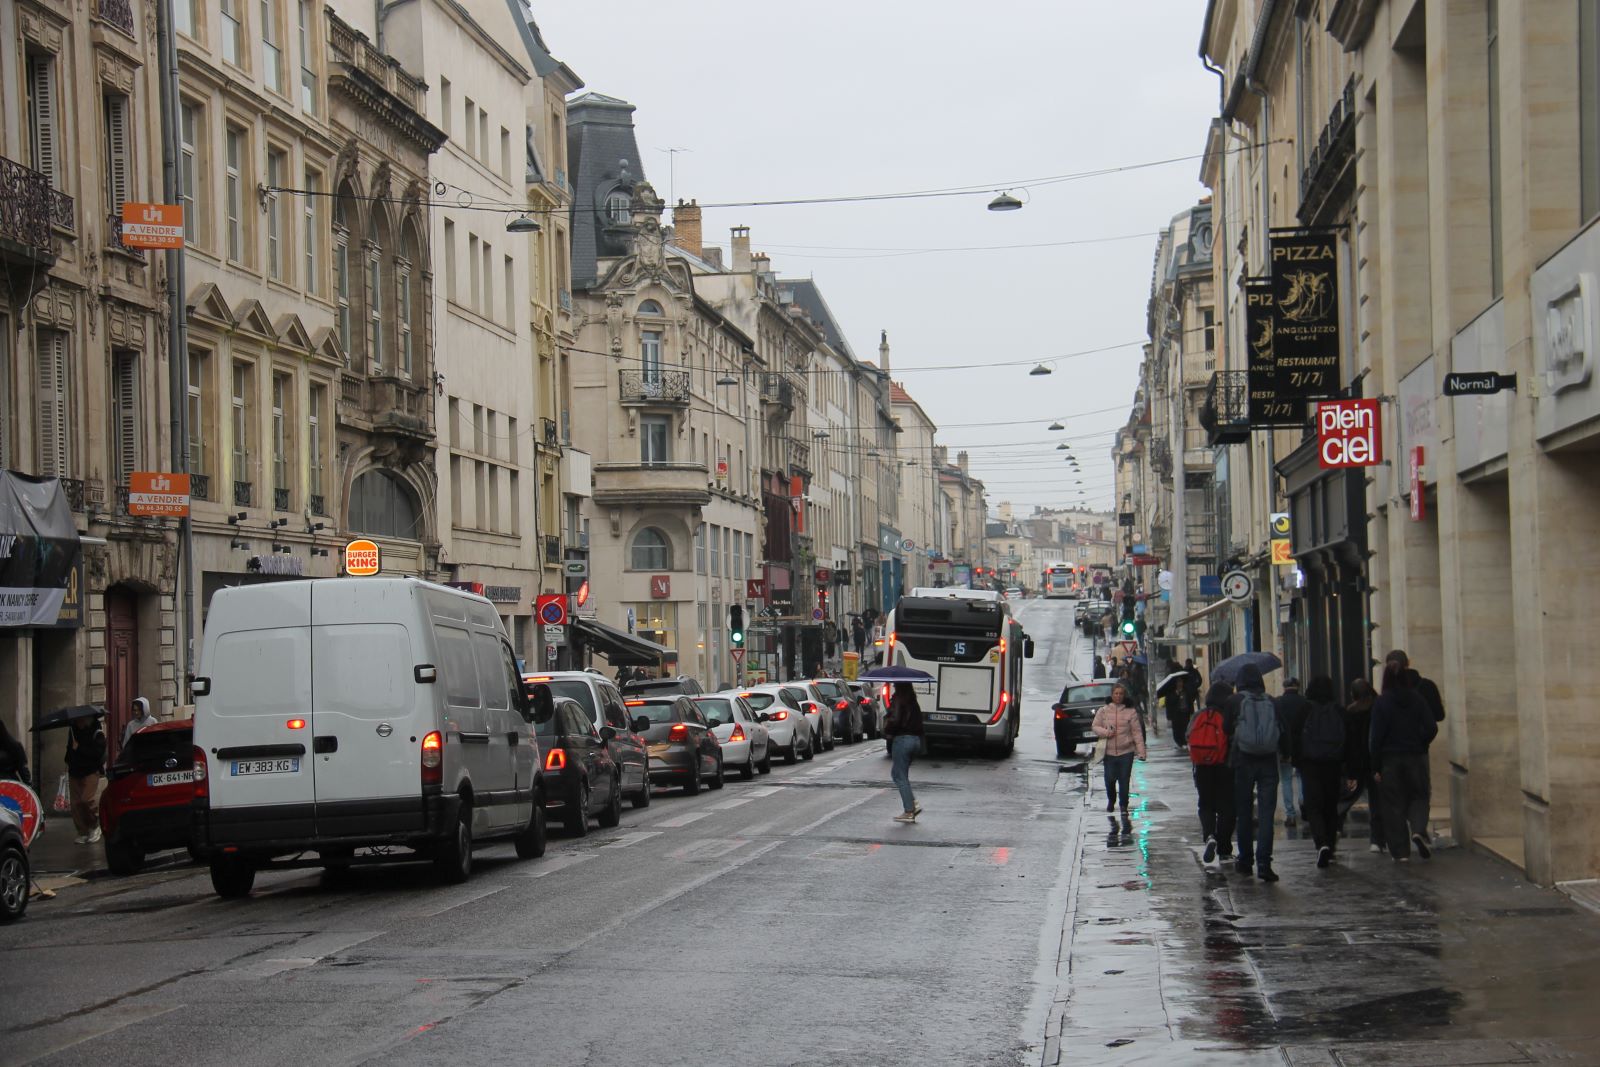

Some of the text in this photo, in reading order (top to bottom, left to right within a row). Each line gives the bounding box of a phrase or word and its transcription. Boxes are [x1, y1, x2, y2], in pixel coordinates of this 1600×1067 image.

[140, 226, 176, 235] VENDRE
[1273, 245, 1335, 261] PIZZA
[1277, 355, 1337, 367] RESTAURANT
[1450, 376, 1495, 391] Normal
[1321, 404, 1374, 435] plein
[1321, 428, 1375, 465] ciel
[147, 496, 183, 504] VENDRE
[347, 558, 378, 568] KING
[954, 642, 965, 654] 15
